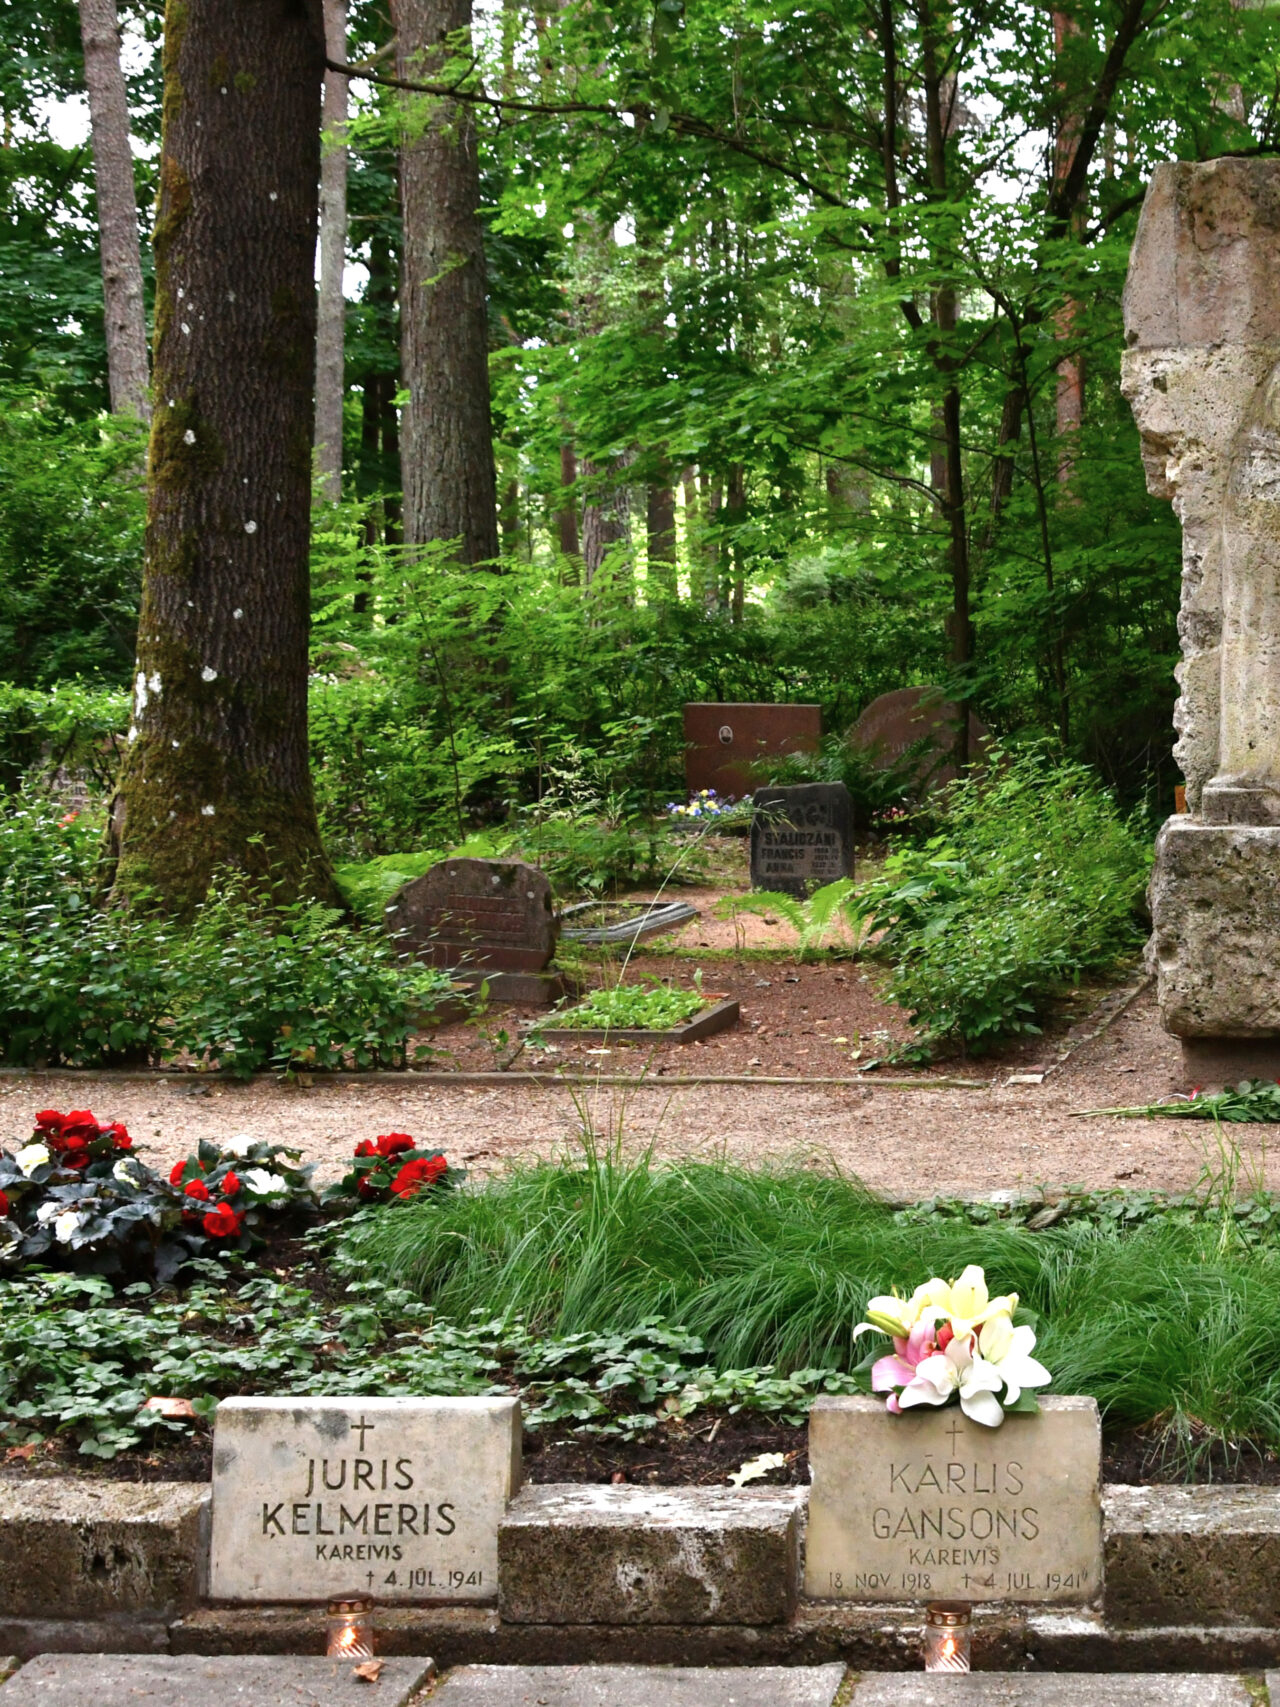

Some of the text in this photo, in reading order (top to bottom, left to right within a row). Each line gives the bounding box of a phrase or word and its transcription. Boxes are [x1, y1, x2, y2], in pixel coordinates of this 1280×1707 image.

[304, 1459, 415, 1498] JURIS
[889, 1454, 1025, 1496] KĀRLIS
[262, 1502, 457, 1540] ĶELMERIS
[872, 1507, 1040, 1541] GANSONS
[315, 1544, 403, 1561] KAREIVIS
[909, 1549, 1000, 1565] KAREIVIS
[384, 1570, 403, 1586] 4.
[448, 1570, 483, 1589] 1941
[902, 1573, 932, 1593] 1918
